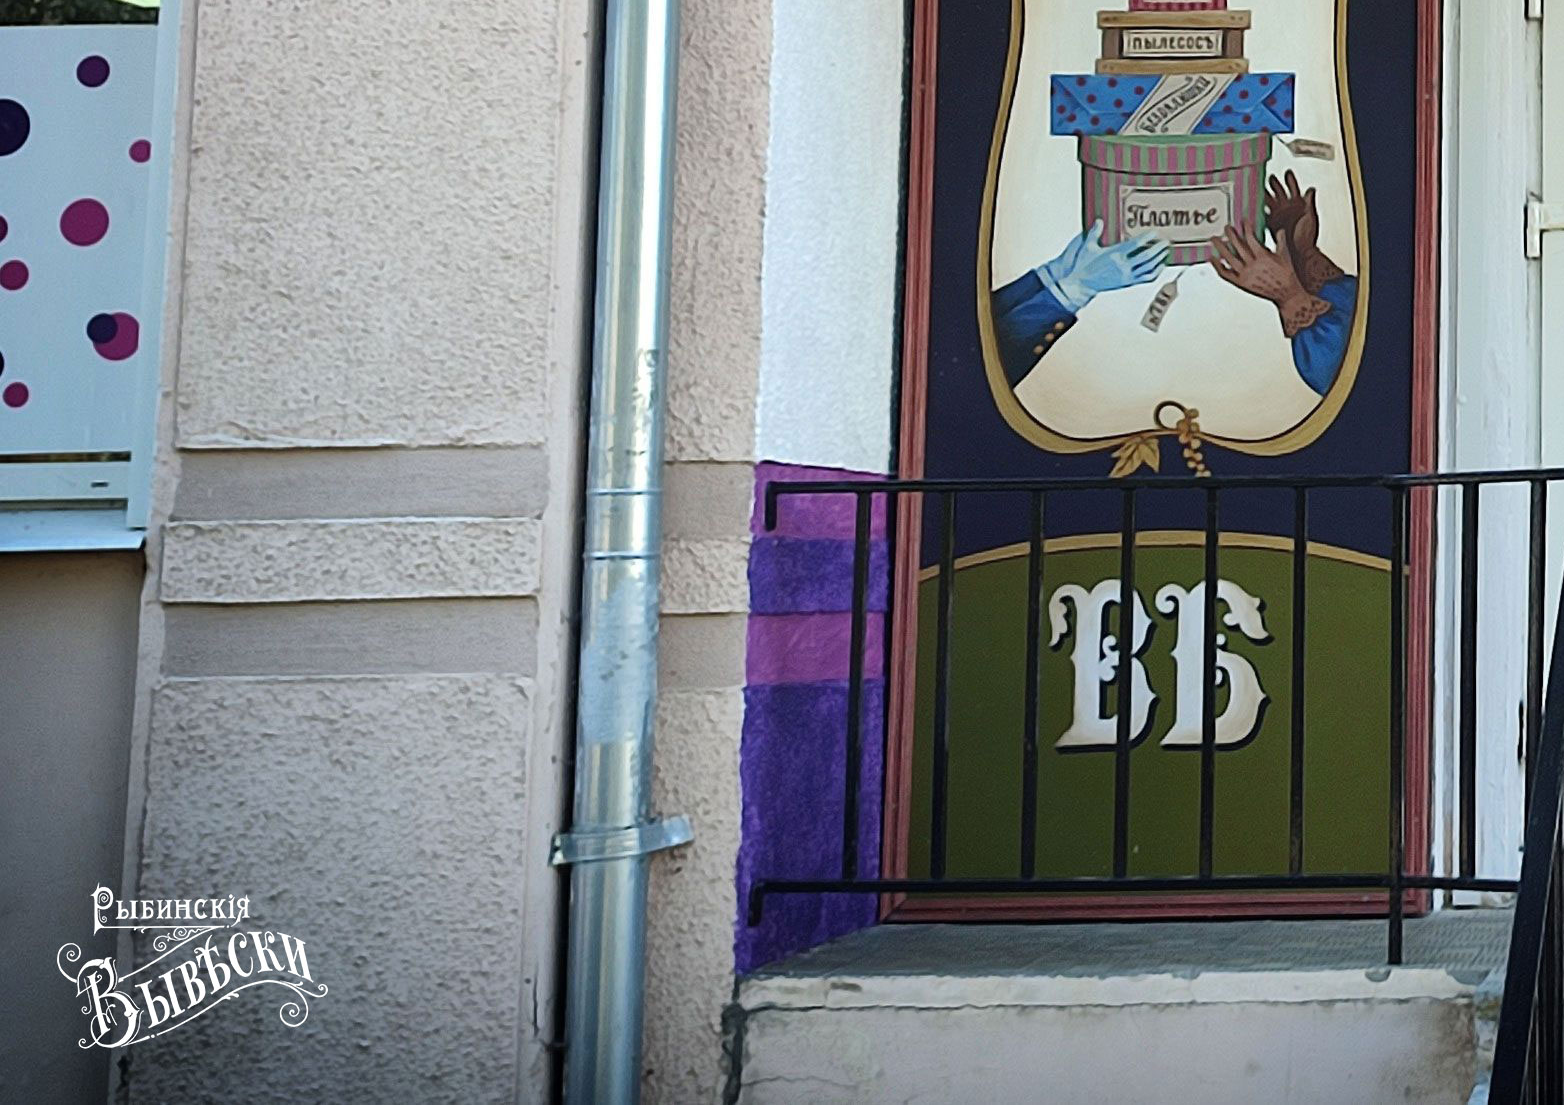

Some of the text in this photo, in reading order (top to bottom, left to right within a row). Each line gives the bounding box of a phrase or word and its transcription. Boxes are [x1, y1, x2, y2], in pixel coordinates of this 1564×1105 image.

[1133, 35, 1214, 50] ПЫЛЕСОСЪ
[1127, 204, 1219, 229] Платье
[1048, 578, 1270, 747] ВБ
